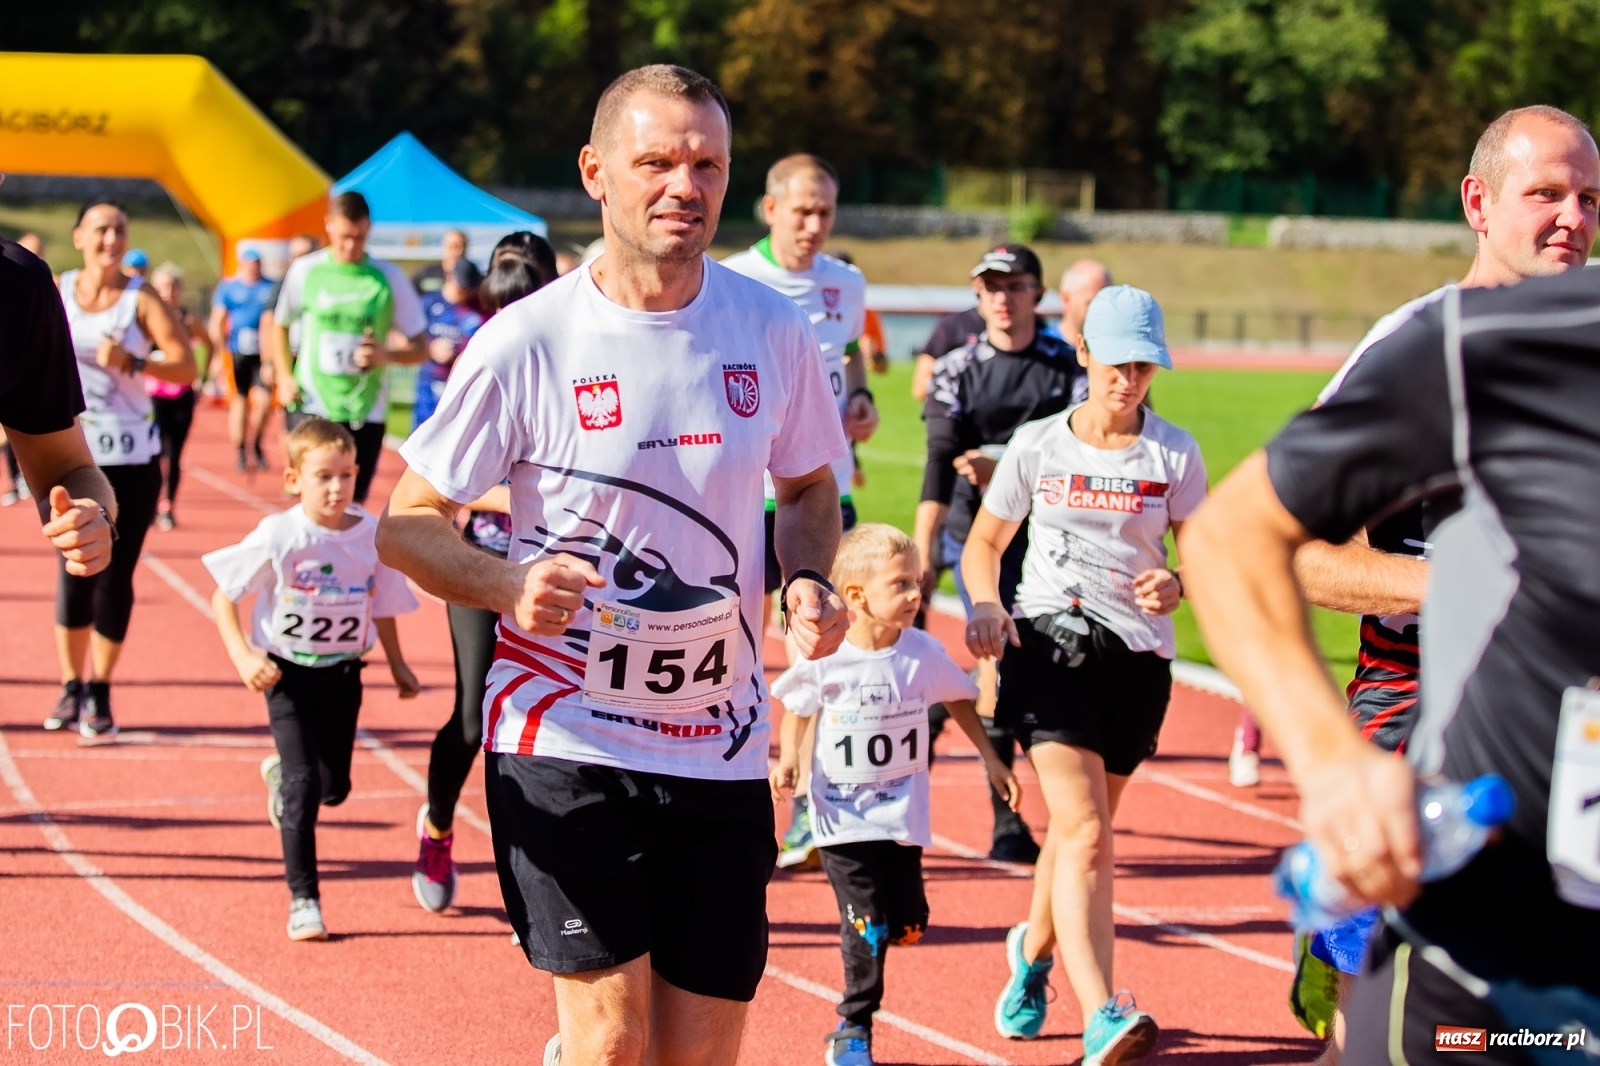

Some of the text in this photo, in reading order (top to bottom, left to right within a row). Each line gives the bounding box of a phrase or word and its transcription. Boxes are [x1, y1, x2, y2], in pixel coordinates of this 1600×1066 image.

[722, 362, 757, 371] RACIBÓRZ
[573, 373, 617, 385] POLSKA
[99, 433, 134, 454] 99
[1071, 475, 1087, 490] X
[1090, 477, 1135, 494] BIEG
[1069, 491, 1142, 512] GRANIC
[601, 603, 641, 618] PersonalBest
[282, 613, 360, 642] 222
[647, 610, 733, 633] www.personalbest.pl
[598, 638, 728, 694] 154
[834, 728, 918, 768] 101
